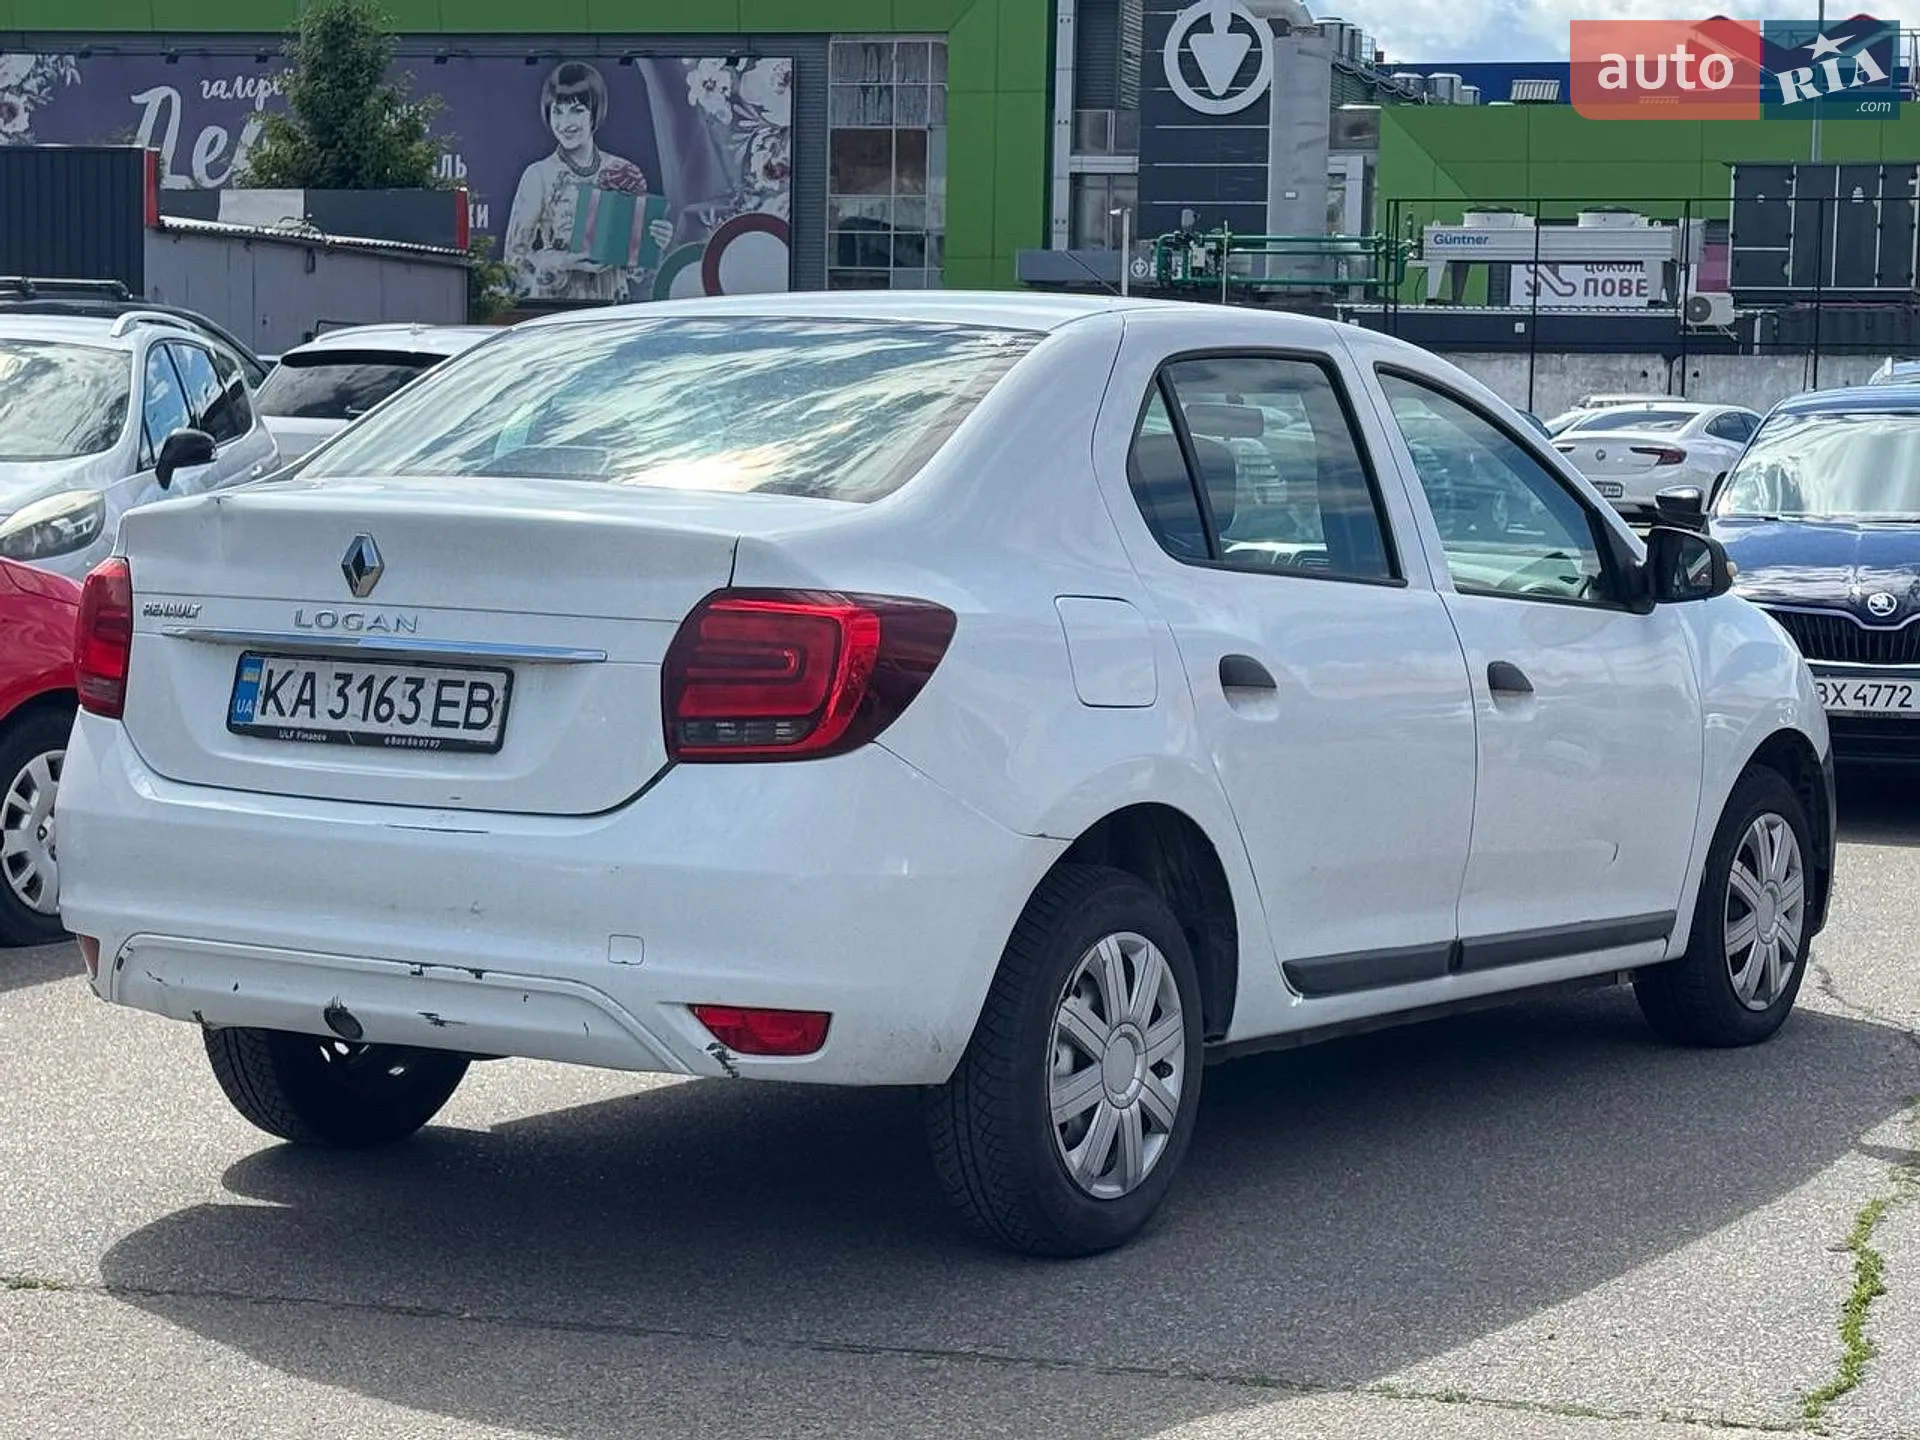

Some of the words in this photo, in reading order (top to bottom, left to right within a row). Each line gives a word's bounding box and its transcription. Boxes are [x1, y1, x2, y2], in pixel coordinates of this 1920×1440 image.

[1433, 233, 1489, 245] Güntner
[1584, 278, 1649, 297] ПОВЕ
[143, 602, 201, 619] RENAULT
[295, 608, 418, 634] LOGAN
[260, 668, 316, 719] KA
[328, 671, 425, 725] 3163
[431, 679, 495, 731] EB
[1853, 684, 1913, 708] 4772
[236, 698, 253, 715] UA
